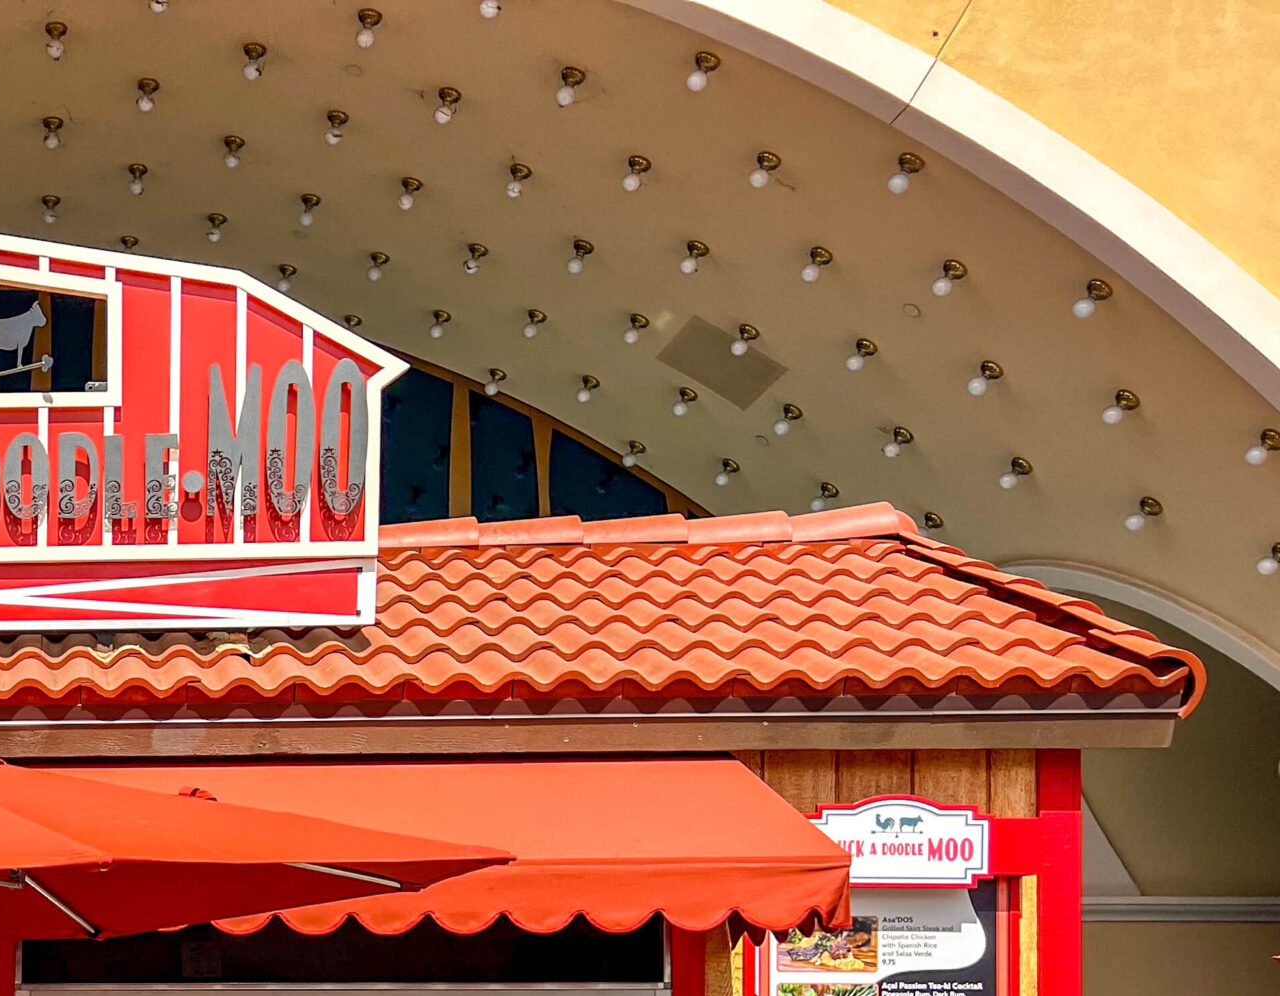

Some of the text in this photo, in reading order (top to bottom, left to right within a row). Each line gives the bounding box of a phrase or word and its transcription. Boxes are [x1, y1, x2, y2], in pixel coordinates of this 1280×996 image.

[207, 359, 367, 518] MOO
[869, 842, 877, 855] A
[882, 843, 924, 856] DOODLE
[928, 837, 974, 862] MOO
